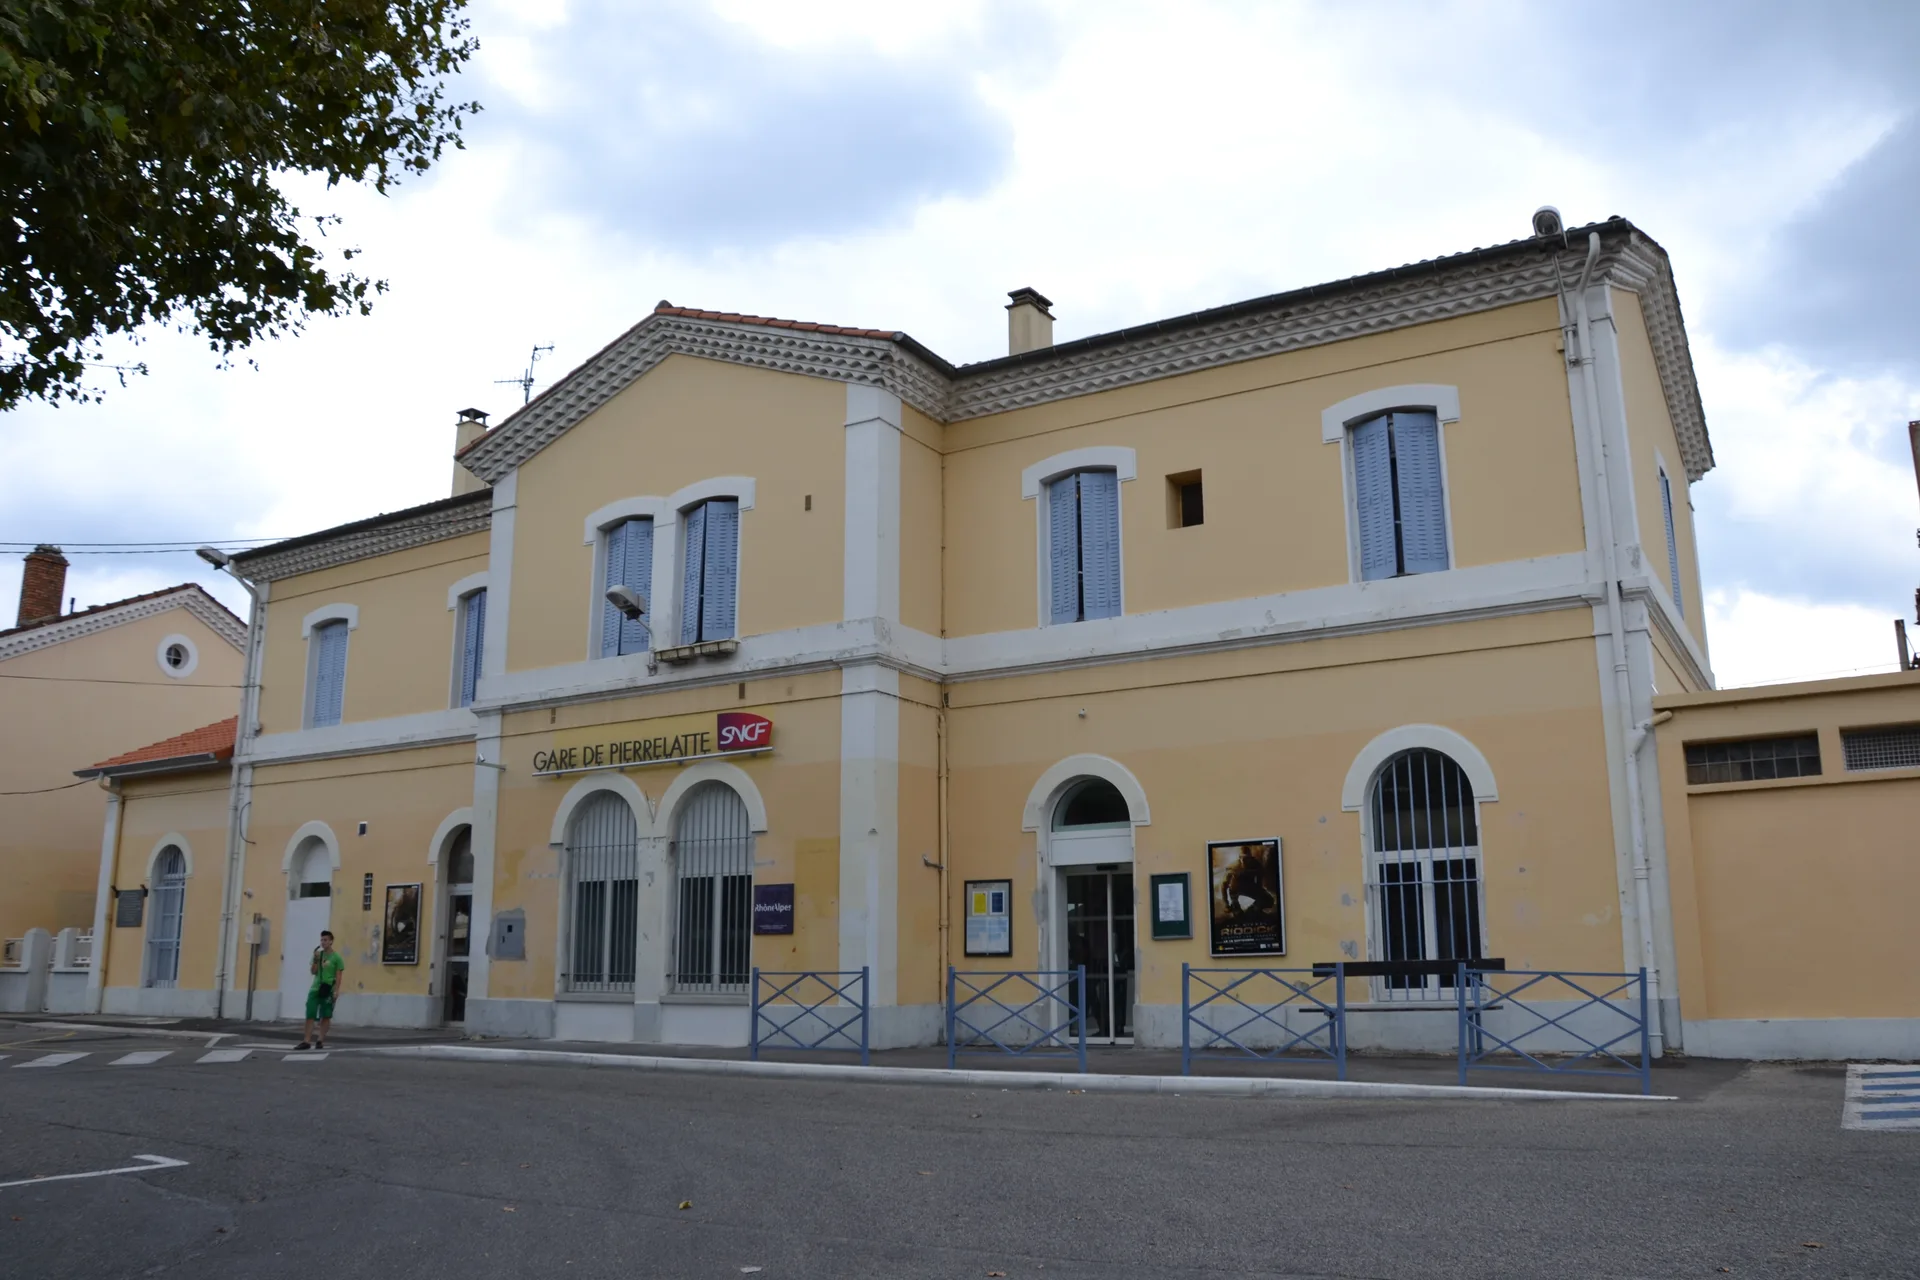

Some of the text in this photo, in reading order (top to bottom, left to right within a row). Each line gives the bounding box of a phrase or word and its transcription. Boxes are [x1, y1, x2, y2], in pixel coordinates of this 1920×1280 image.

[720, 722, 769, 745] SNCF
[533, 732, 710, 771] GARE DE PIERRELATTE
[1220, 926, 1275, 936] RIDDICK
